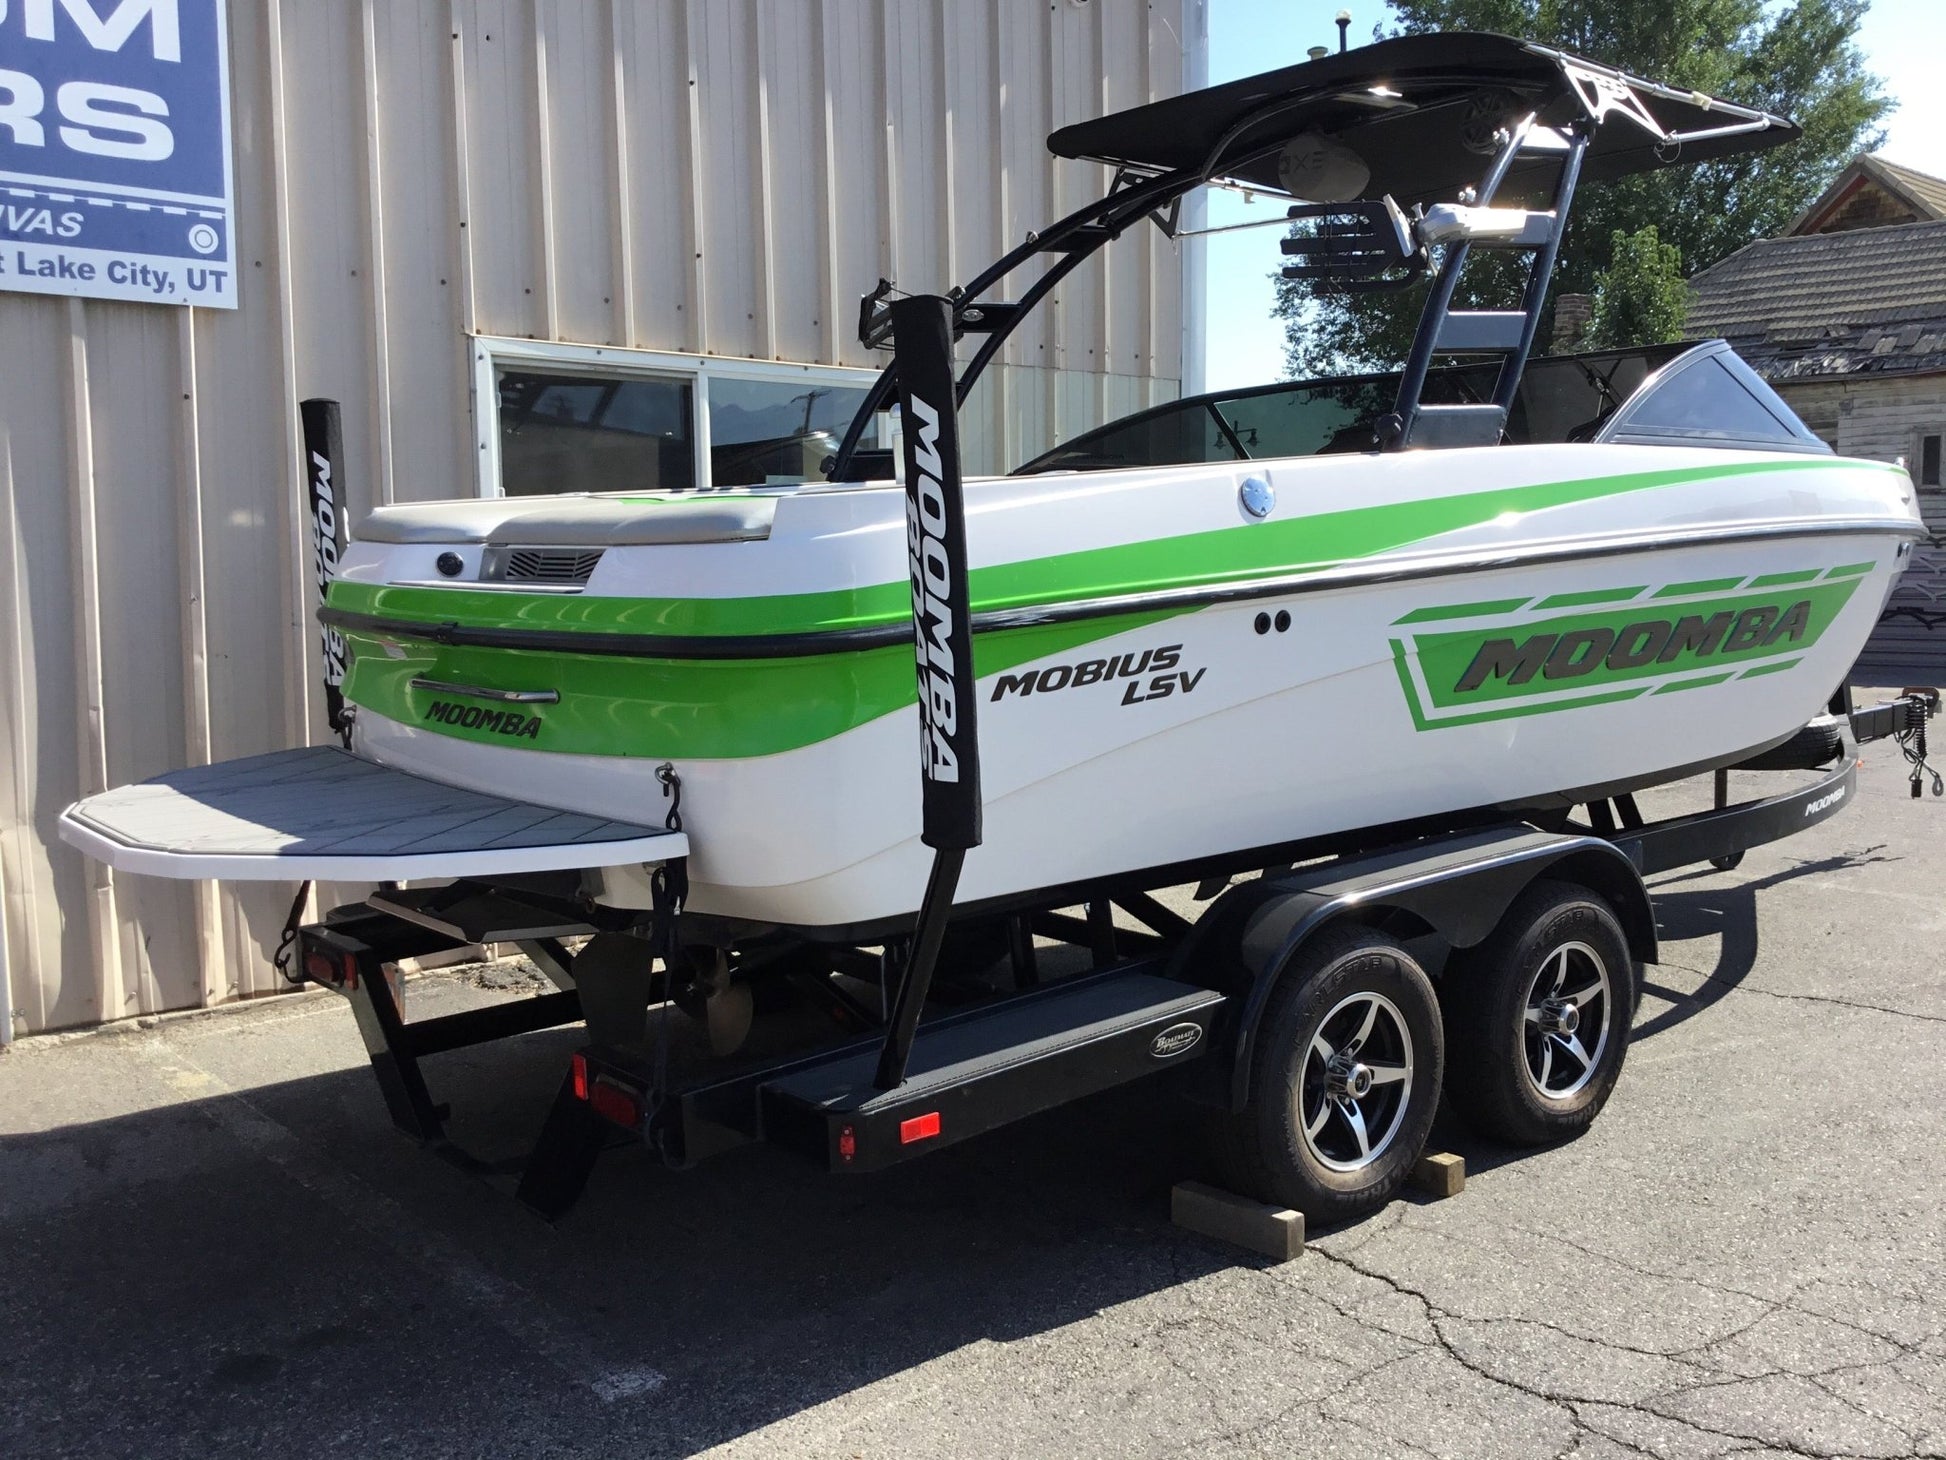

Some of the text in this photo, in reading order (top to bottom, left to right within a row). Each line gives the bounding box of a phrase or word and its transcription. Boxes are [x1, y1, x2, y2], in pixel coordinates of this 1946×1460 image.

[0, 204, 84, 238] VAS
[17, 251, 96, 281] Lake
[107, 260, 175, 294] City,
[187, 268, 228, 293] UT
[312, 450, 346, 687] MOOBA
[909, 393, 960, 783] MOOMBA
[1453, 600, 1813, 694] MOOMBA
[990, 643, 1184, 703] MOBIUS
[1120, 667, 1208, 707] LSV
[424, 700, 542, 740] MOOMBA
[1804, 785, 1846, 817] MOOMBA
